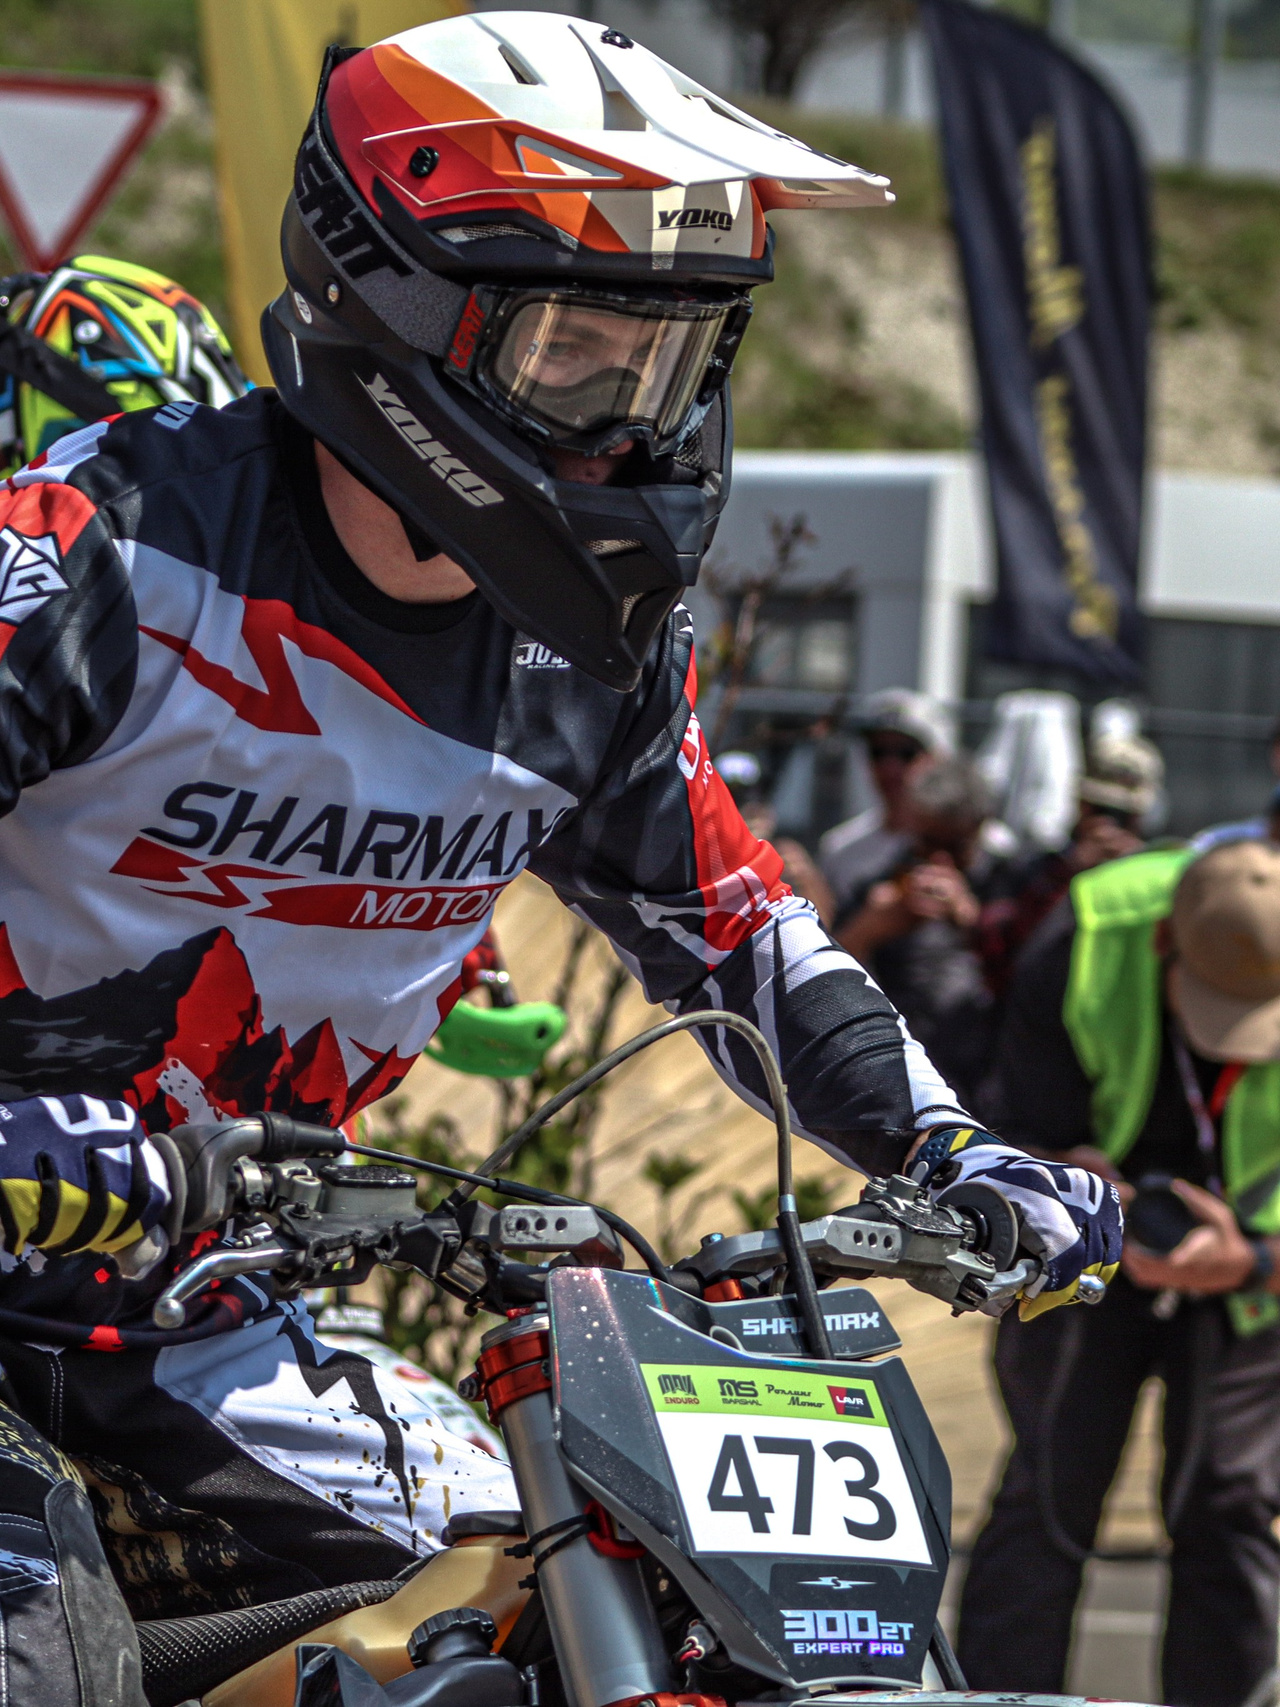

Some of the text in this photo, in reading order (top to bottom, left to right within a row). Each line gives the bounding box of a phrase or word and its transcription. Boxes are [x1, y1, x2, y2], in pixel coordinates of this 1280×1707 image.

[654, 208, 734, 232] YOKO
[360, 373, 506, 508] YOKO
[515, 642, 572, 668] JU
[139, 780, 573, 881] SHARMAX
[741, 1311, 880, 1335] SHAMAX
[664, 1396, 700, 1405] ENDURO
[835, 1395, 864, 1406] LAVR
[707, 1434, 898, 1541] 473
[793, 1641, 905, 1655] EXPERT PRO
